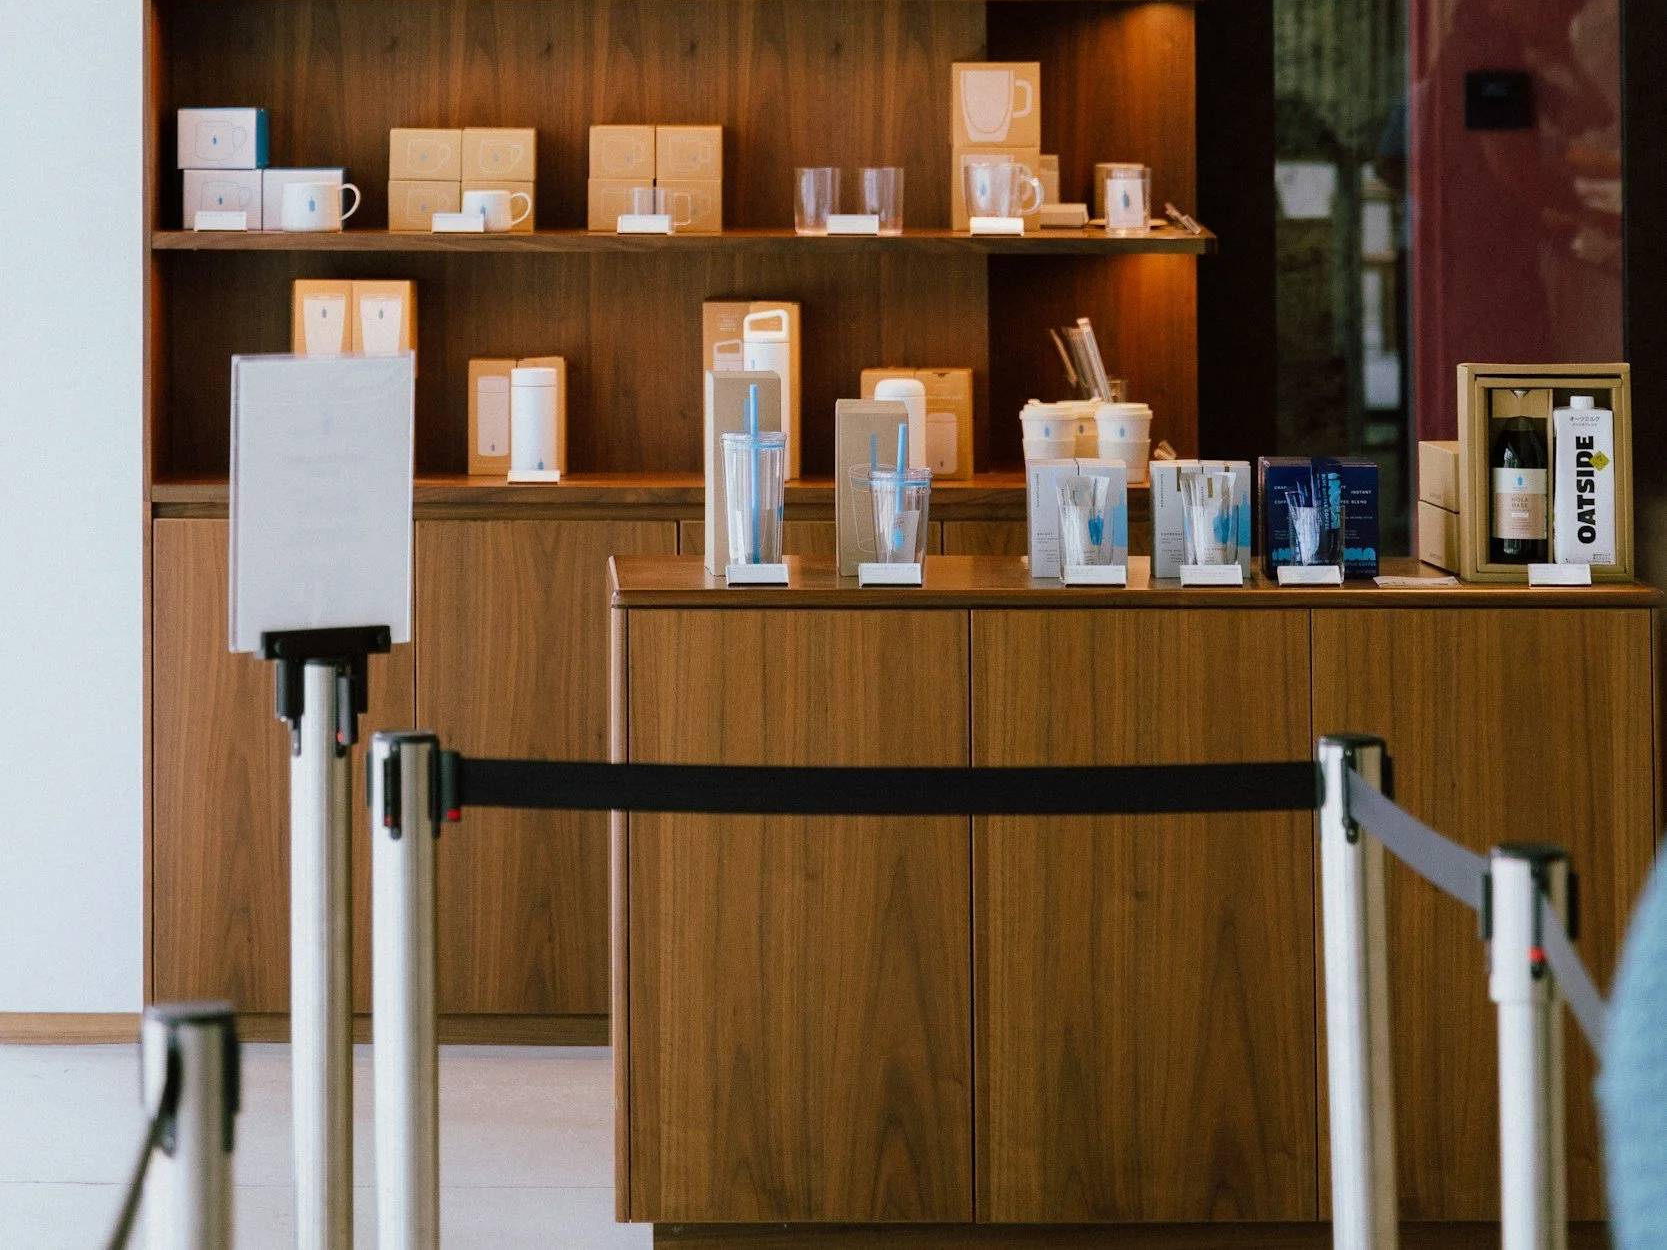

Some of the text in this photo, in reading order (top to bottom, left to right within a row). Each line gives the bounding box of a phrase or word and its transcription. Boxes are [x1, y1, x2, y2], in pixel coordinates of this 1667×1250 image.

[1321, 488, 1329, 508] BOTTLE
[1575, 435, 1597, 545] OATSIDE
[1344, 547, 1377, 561] OLA
